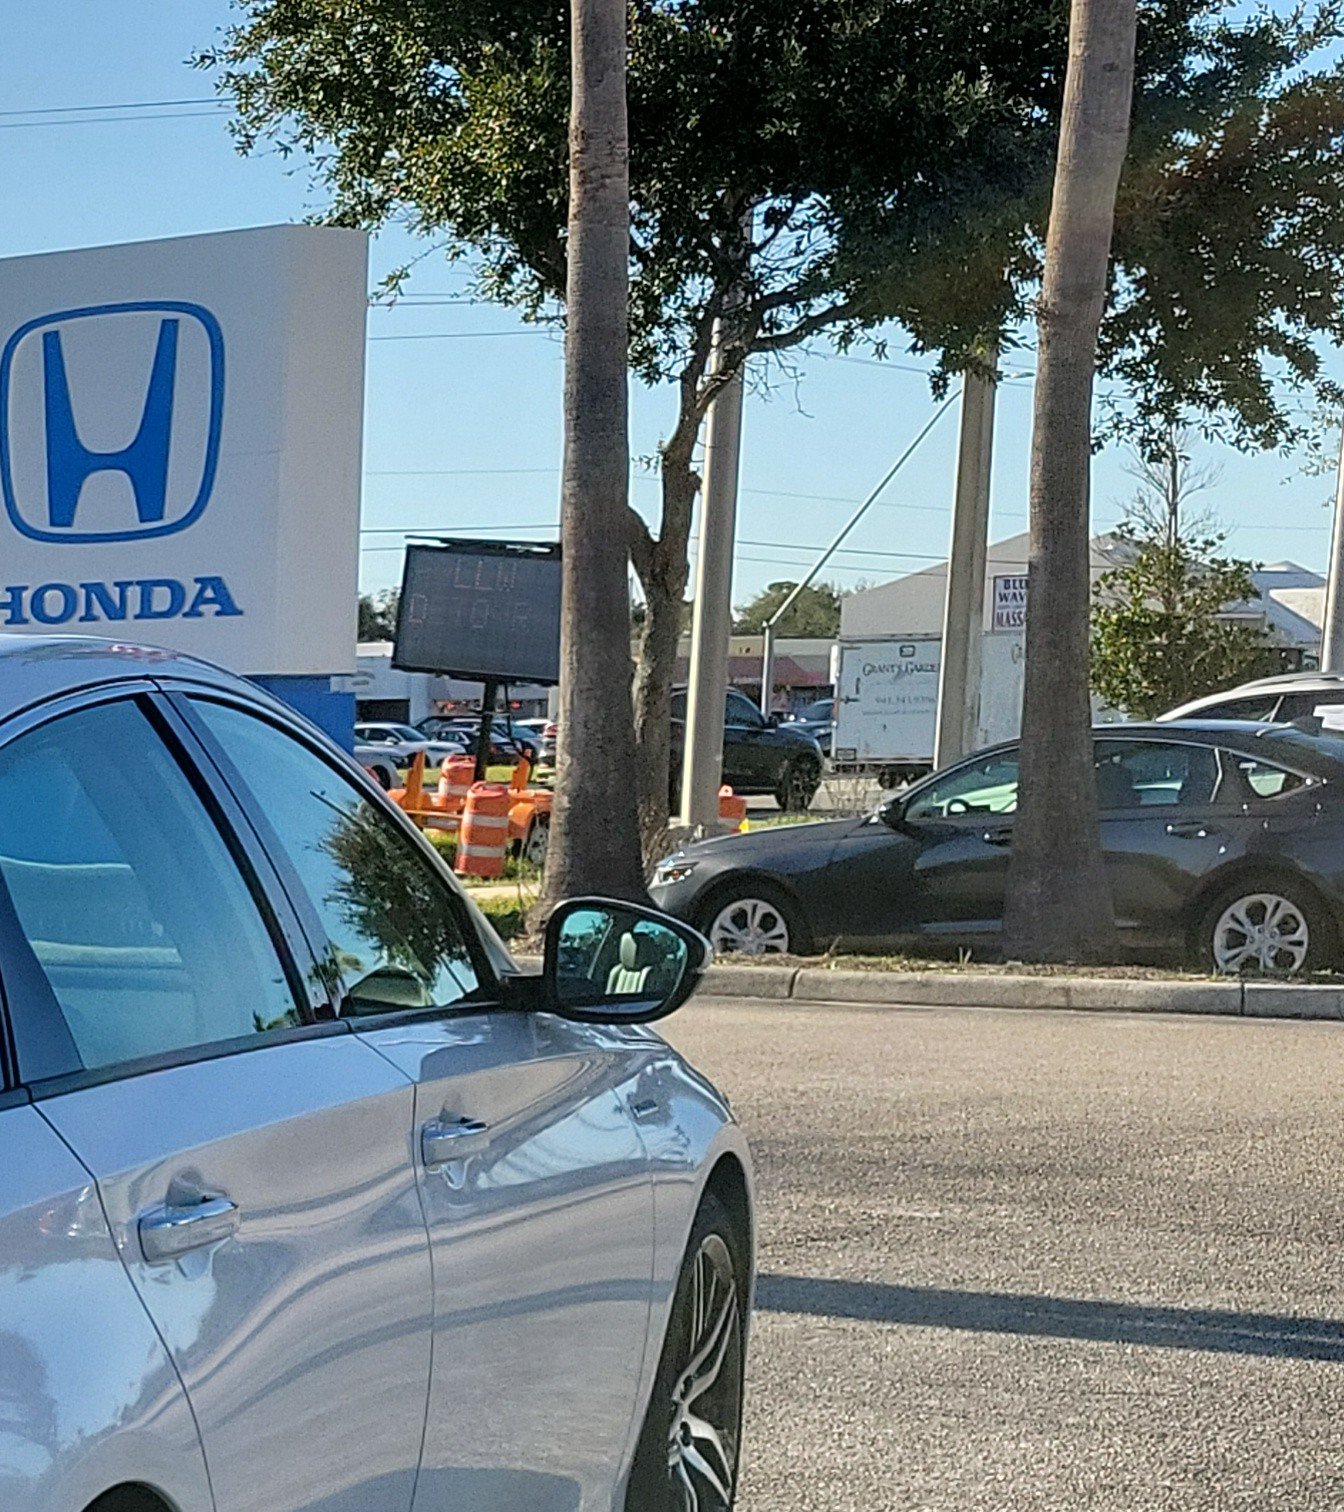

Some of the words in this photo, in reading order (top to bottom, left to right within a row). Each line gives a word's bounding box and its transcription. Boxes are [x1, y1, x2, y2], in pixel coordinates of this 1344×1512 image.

[1003, 578, 1029, 590] BLU
[998, 591, 1026, 603] WAV
[996, 610, 1024, 628] MASS
